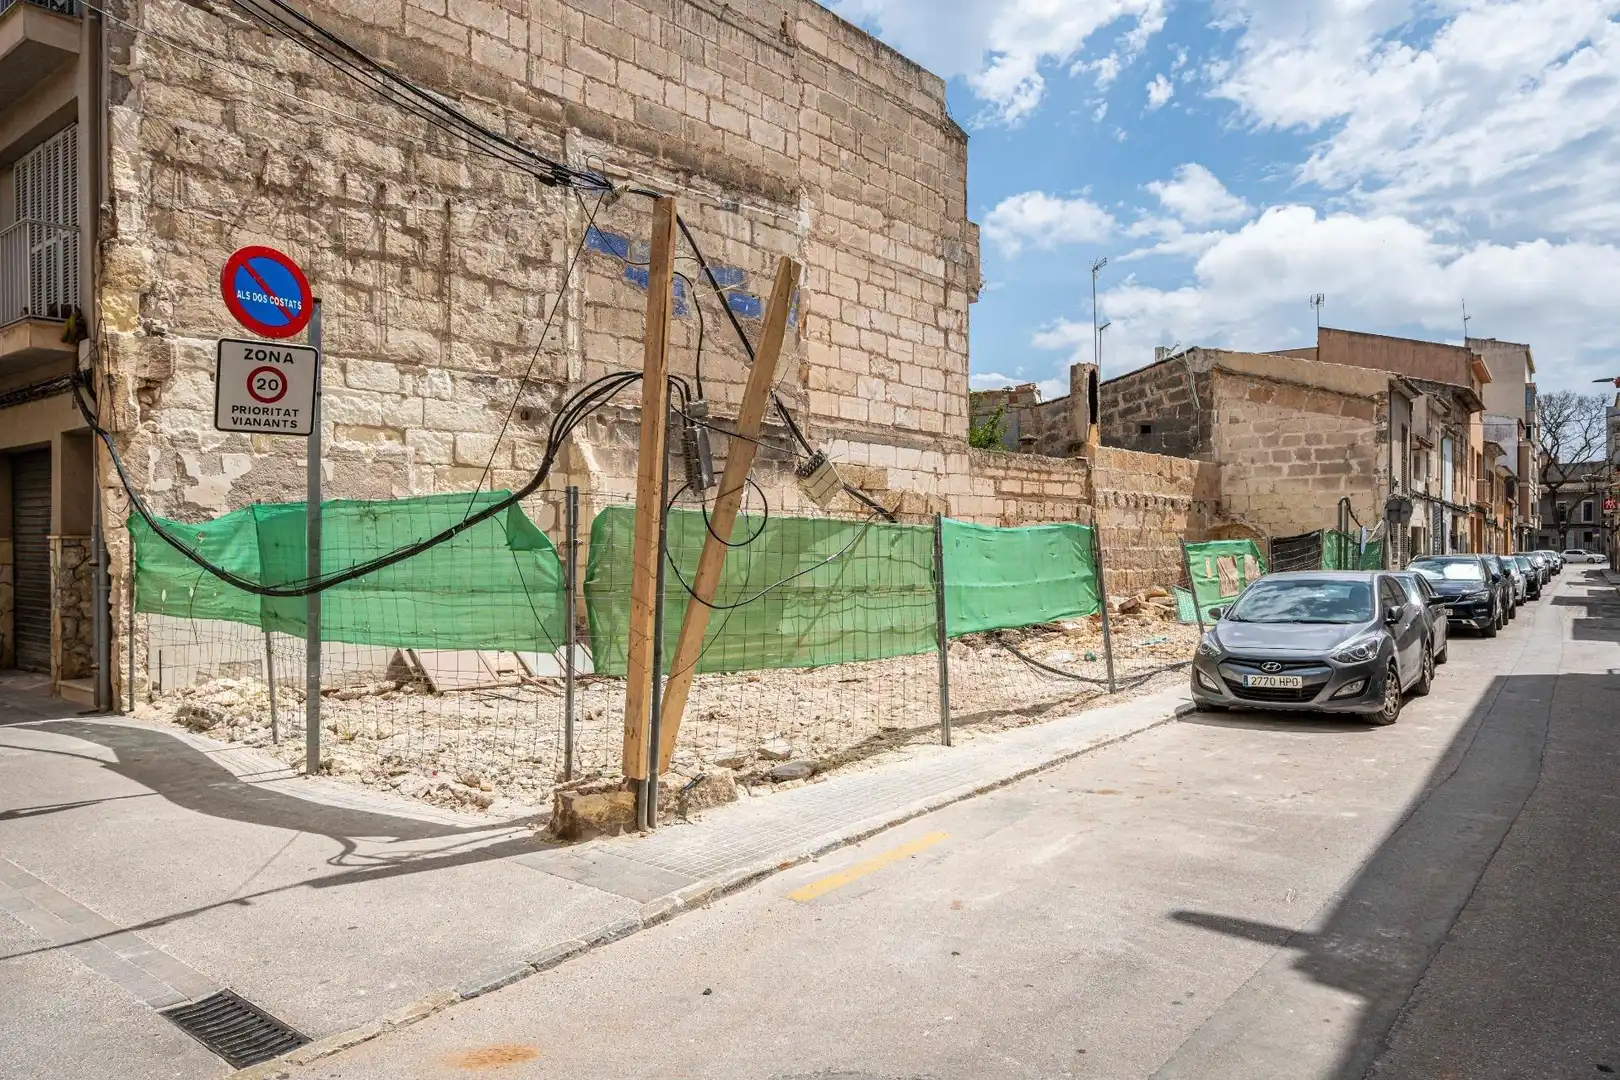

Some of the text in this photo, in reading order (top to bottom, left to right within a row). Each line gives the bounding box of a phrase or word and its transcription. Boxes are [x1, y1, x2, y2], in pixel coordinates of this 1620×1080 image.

[236, 289, 302, 310] ALS DOS COSTATS
[244, 348, 294, 364] ZONA
[256, 378, 279, 391] 20
[231, 405, 299, 418] PRIORITAT
[231, 417, 298, 429] VIANANTS
[1251, 676, 1276, 687] 2770
